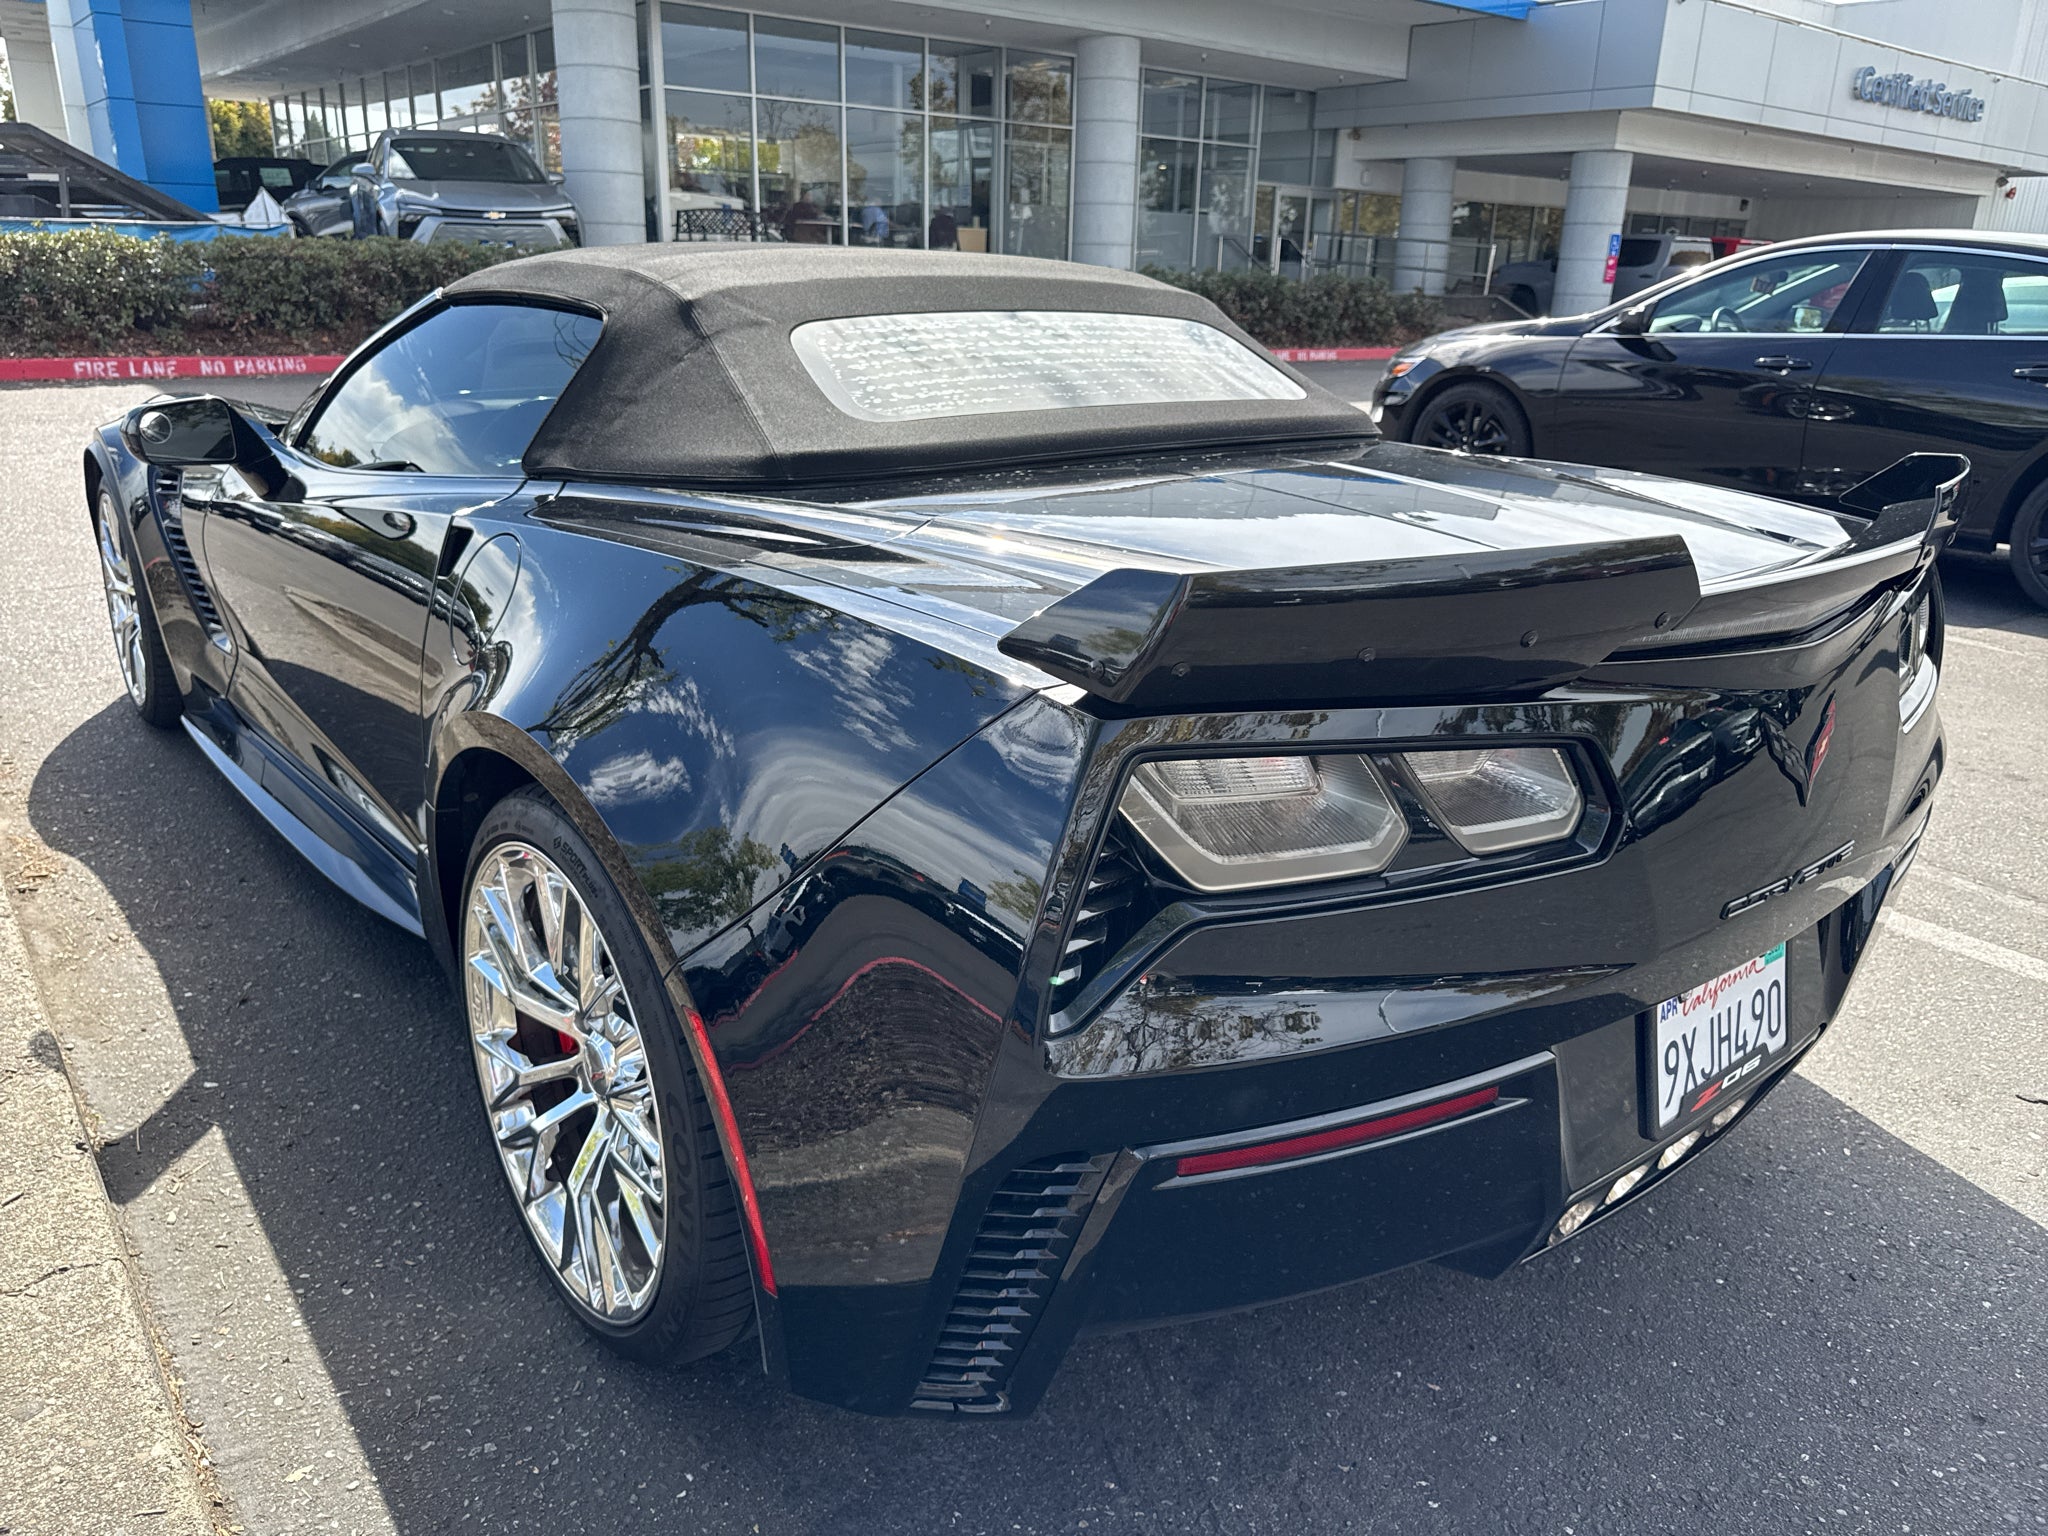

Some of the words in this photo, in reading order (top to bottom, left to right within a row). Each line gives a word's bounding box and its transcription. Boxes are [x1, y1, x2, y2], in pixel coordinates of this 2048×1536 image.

[1853, 66, 1934, 112] Certified
[1933, 82, 1985, 122] Service
[73, 361, 120, 378] FIRE
[128, 360, 178, 377] LANE
[200, 359, 226, 375] NO
[234, 357, 307, 374] PARKING
[1719, 839, 1856, 920] CORVETTE
[1659, 996, 1679, 1024] APR
[1682, 959, 1767, 1017] California
[1664, 979, 1782, 1109] 9XJH490
[1690, 1053, 1762, 1113] Z06
